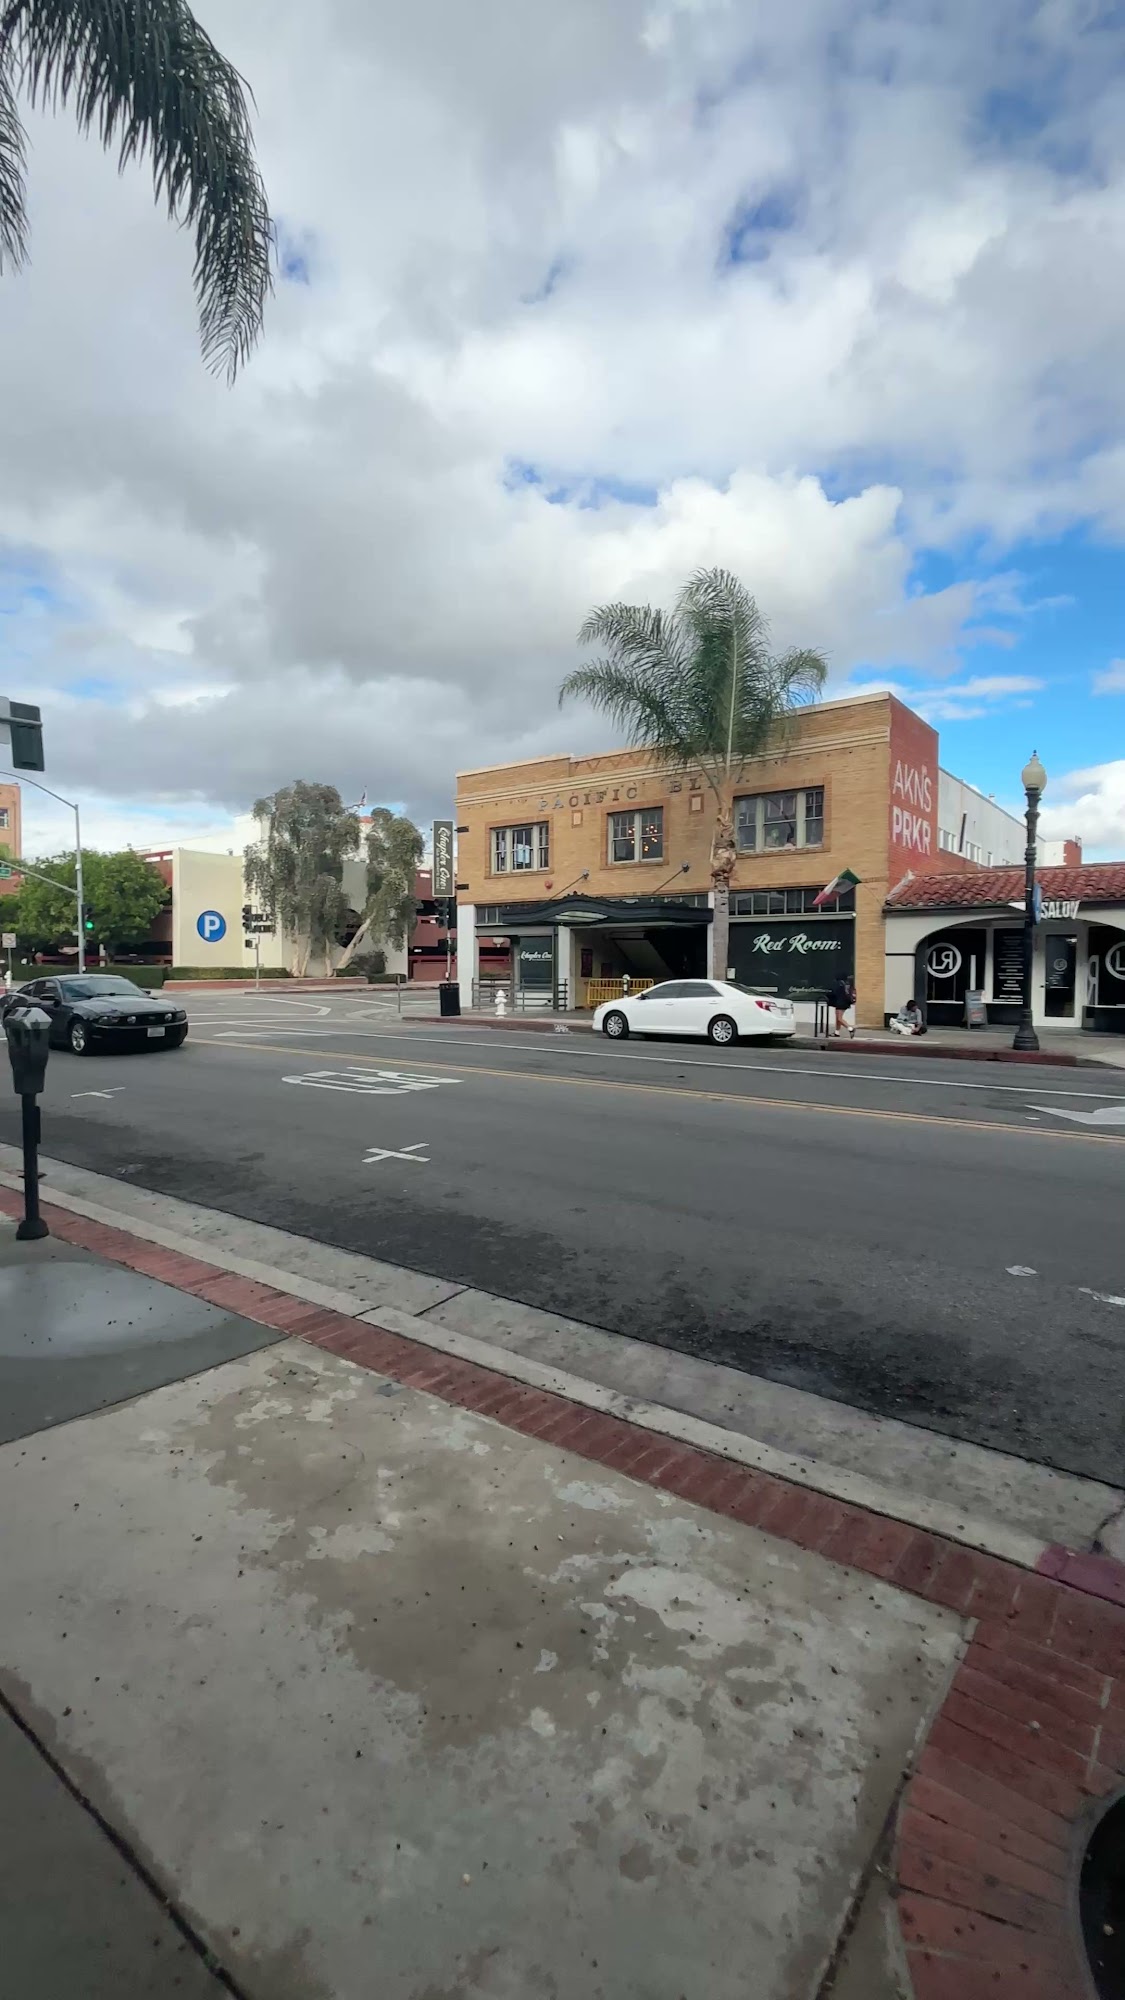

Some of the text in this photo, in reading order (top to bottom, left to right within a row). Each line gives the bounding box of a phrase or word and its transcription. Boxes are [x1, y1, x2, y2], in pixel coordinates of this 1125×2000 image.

[538, 786, 638, 811] PACIFIC
[892, 805, 931, 856] PRKR
[436, 827, 451, 866] Chapter
[204, 915, 220, 938] P
[751, 933, 787, 954] Red
